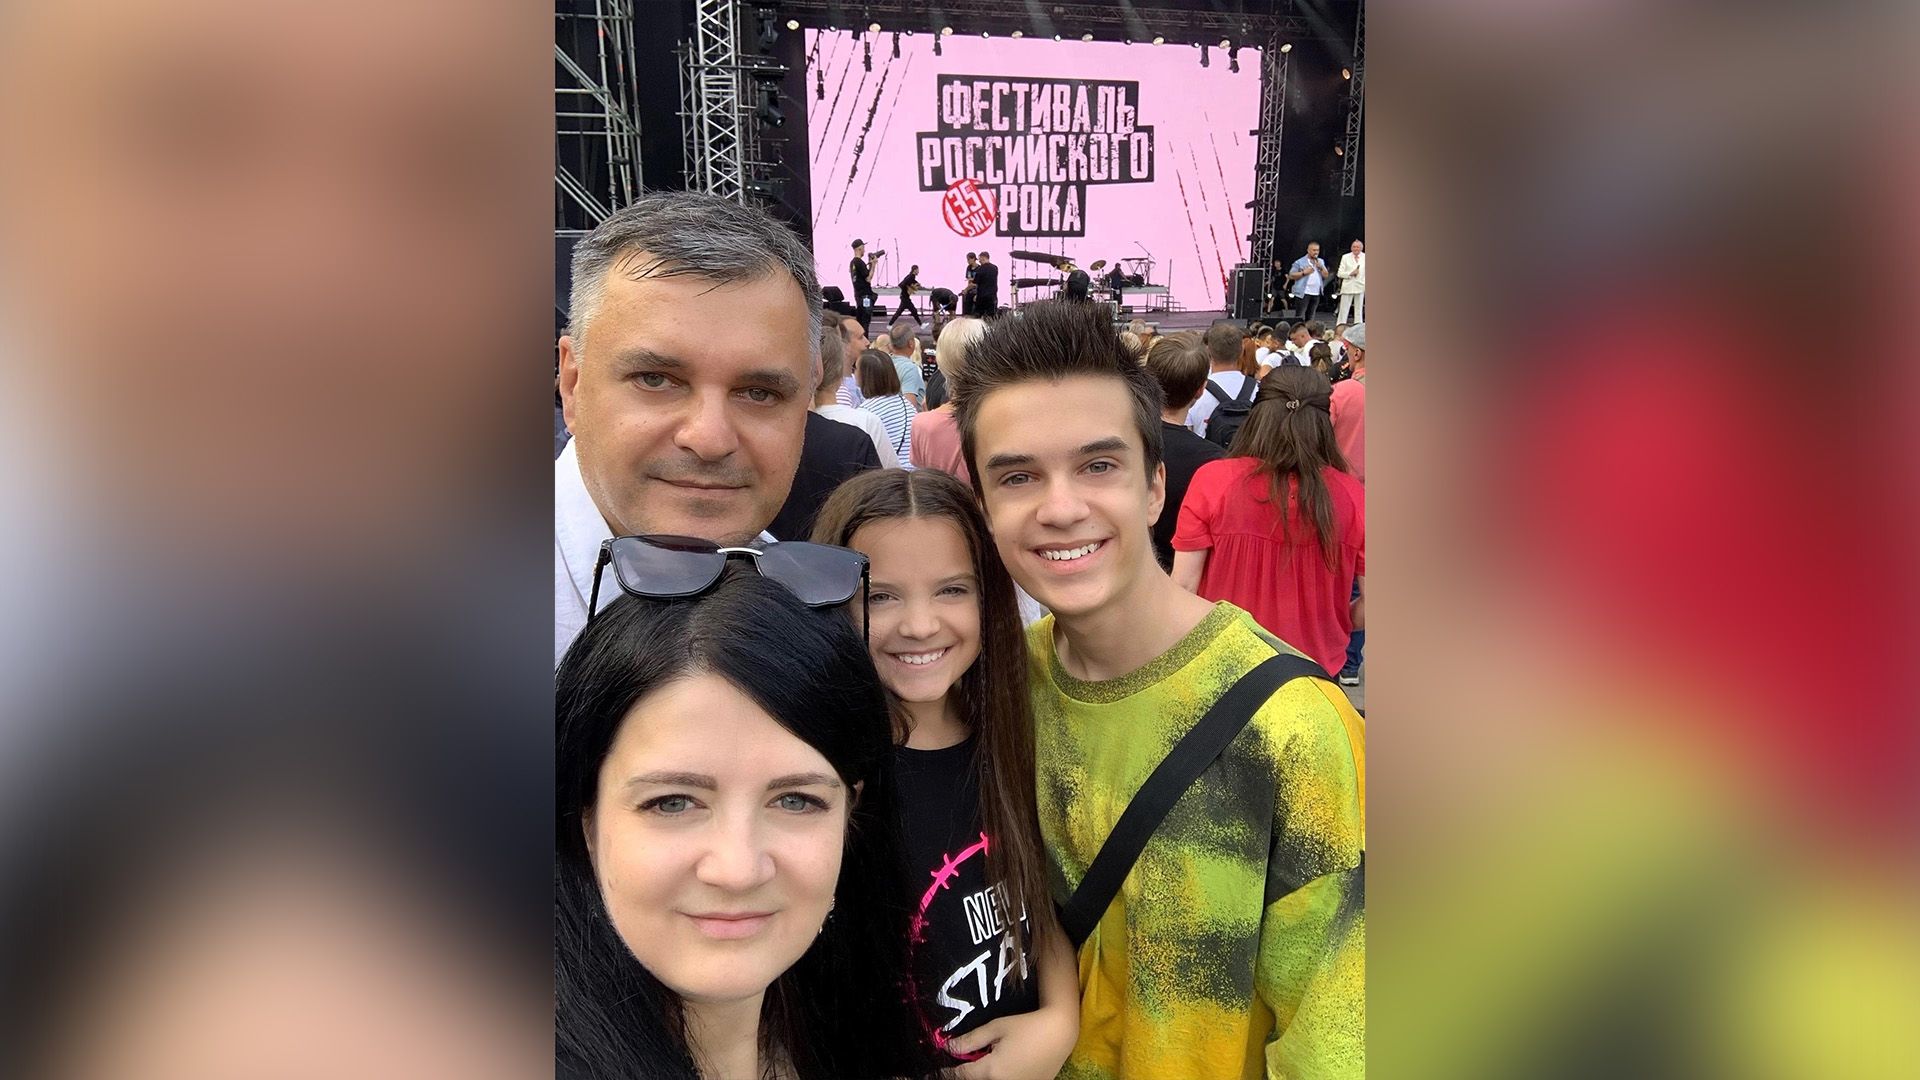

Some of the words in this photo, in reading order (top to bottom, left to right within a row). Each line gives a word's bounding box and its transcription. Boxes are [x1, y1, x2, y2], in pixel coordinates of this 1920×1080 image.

[942, 80, 1135, 134] ФЕСТИВАЛЬ
[921, 128, 1150, 187] РОССИЙСКОГО
[946, 180, 983, 220] 35
[962, 208, 992, 237] SNC
[999, 184, 1081, 232] РОКА
